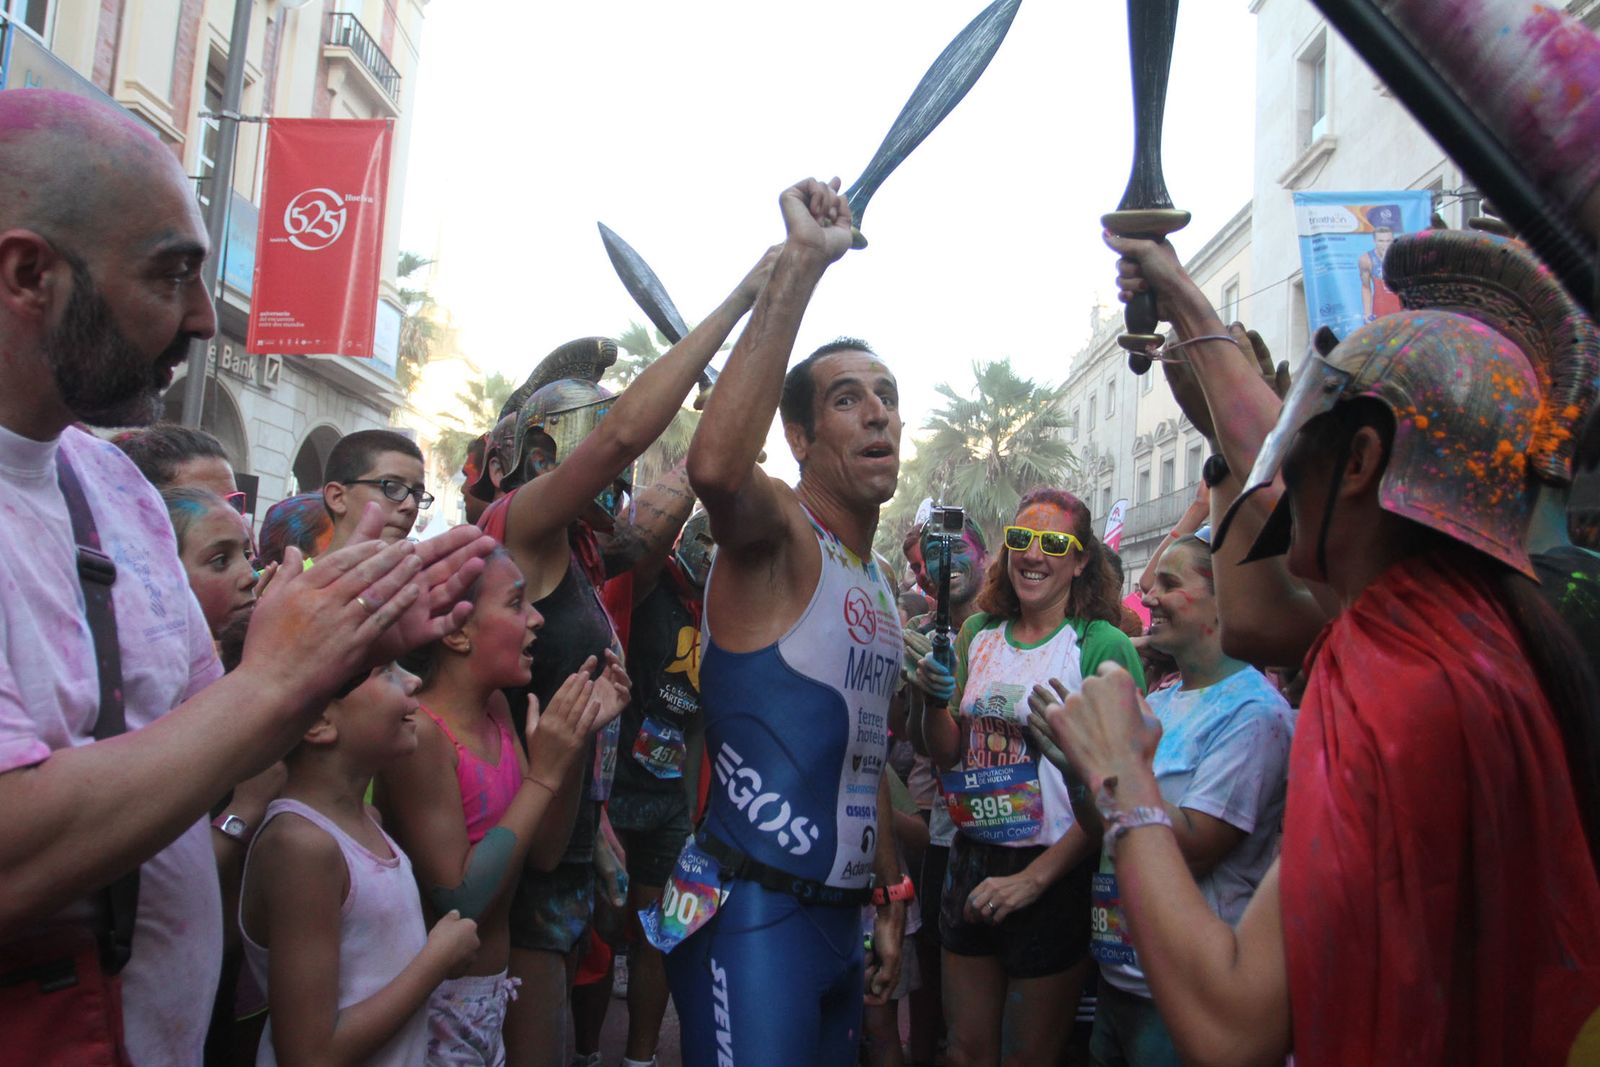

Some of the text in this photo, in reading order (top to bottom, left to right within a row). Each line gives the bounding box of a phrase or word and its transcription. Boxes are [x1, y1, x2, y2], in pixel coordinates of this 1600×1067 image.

[285, 194, 347, 243] 525
[222, 345, 257, 379] Bank
[844, 592, 876, 640] 525
[856, 725, 885, 746] hotels
[987, 774, 1012, 783] HUELVA
[970, 794, 1013, 819] 395
